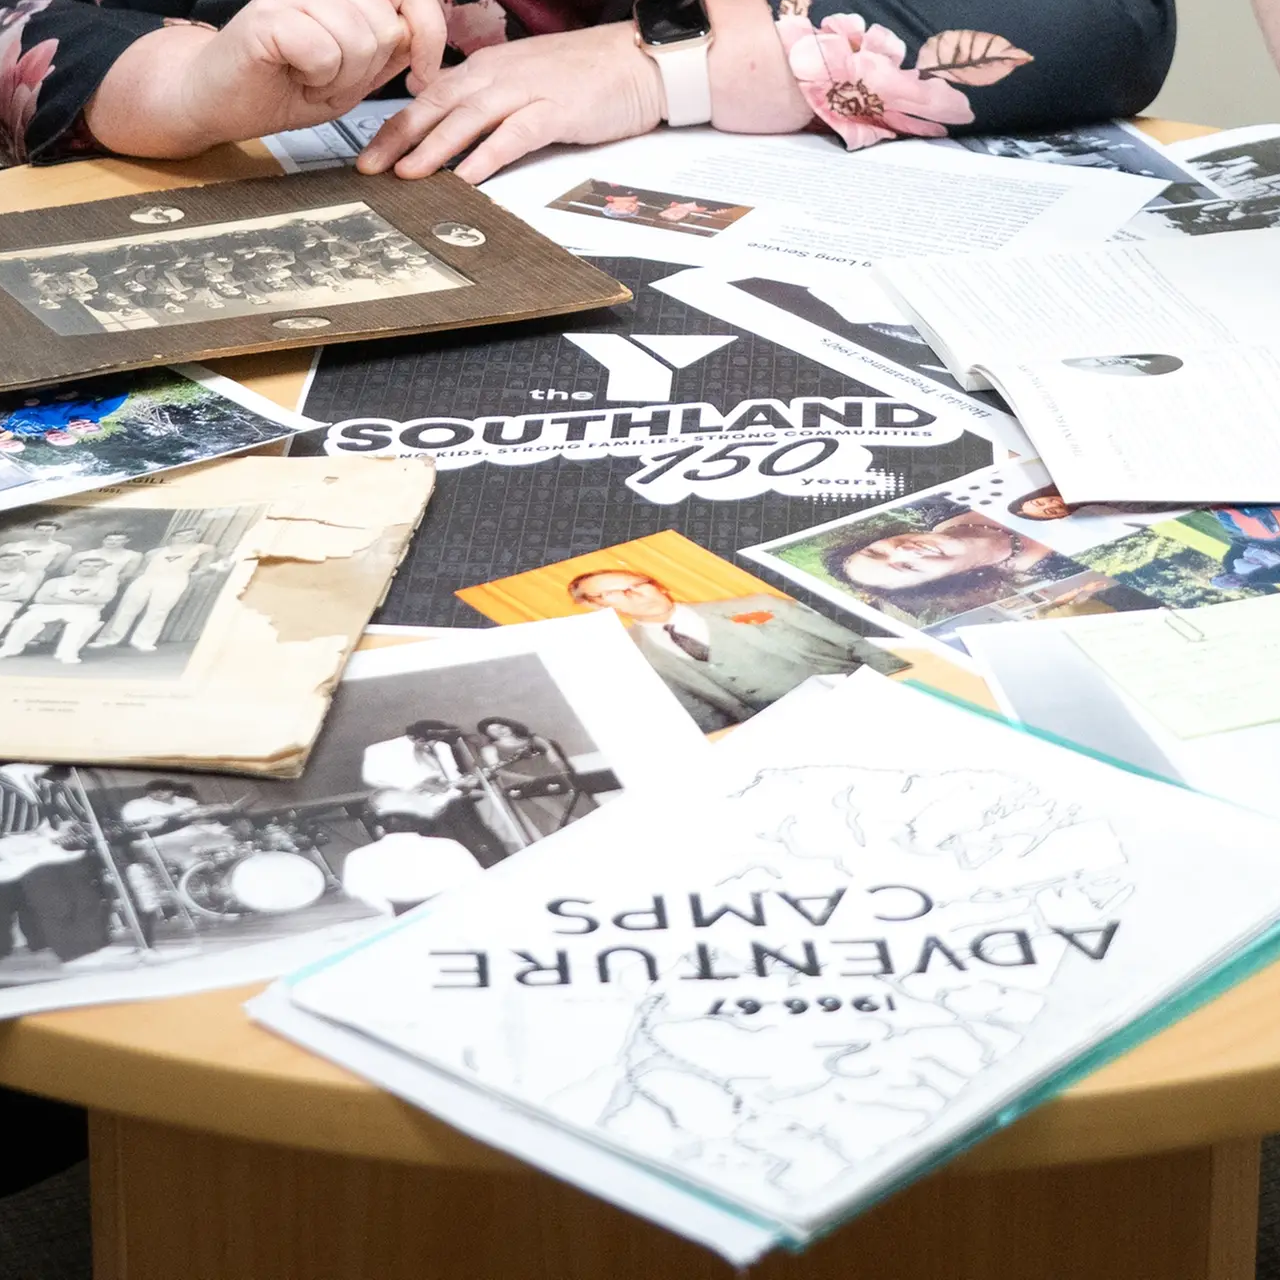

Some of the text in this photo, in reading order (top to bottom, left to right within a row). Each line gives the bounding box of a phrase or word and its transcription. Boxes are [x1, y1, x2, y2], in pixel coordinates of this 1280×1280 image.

[747, 241, 811, 259] Service
[814, 252, 857, 269] Long
[859, 354, 937, 396] Programmes
[528, 388, 594, 401] the
[336, 402, 938, 452] SOUTHLAND
[498, 444, 581, 455] STRONG
[693, 431, 776, 442] STRONG
[784, 429, 933, 438] COMMUNITIES
[636, 437, 839, 485] 150
[801, 475, 877, 486] years
[546, 883, 935, 936] CAMPS
[428, 919, 1122, 990] ADVENTURE
[707, 993, 897, 1017] 1966-67
